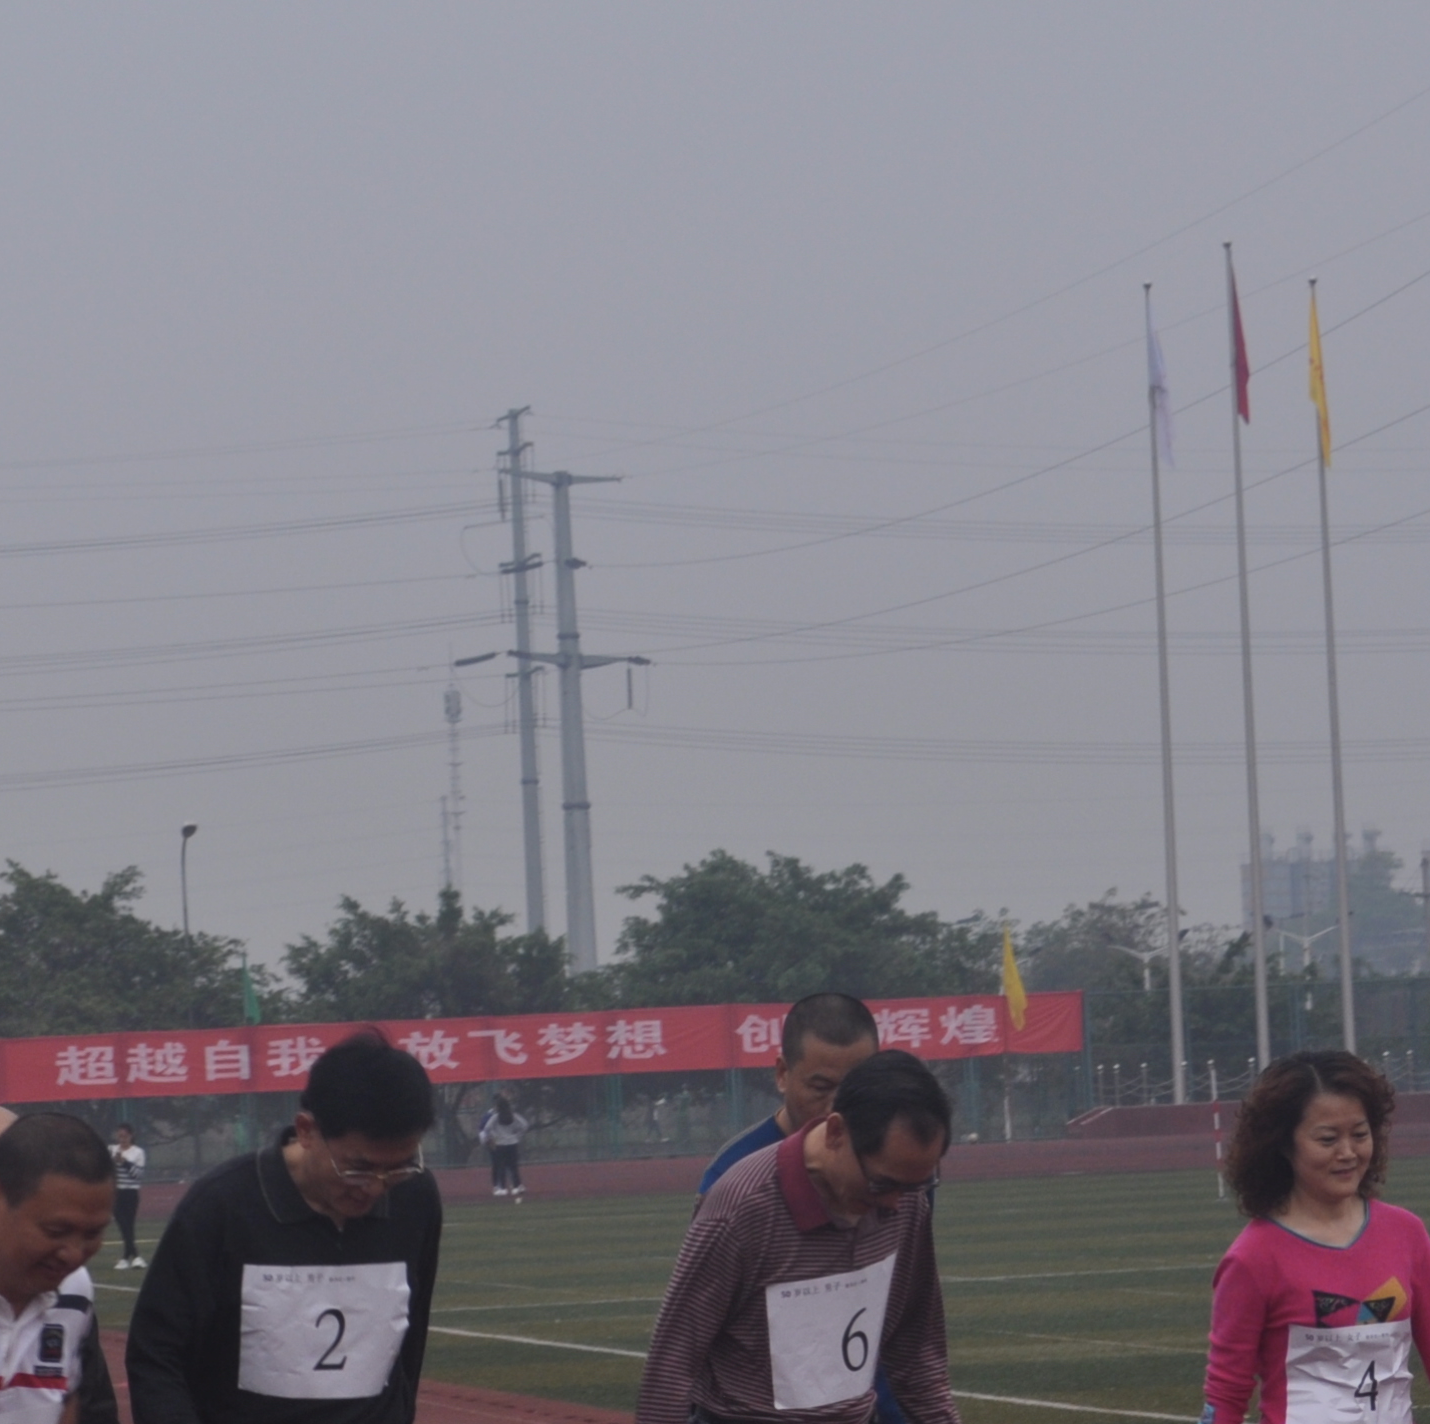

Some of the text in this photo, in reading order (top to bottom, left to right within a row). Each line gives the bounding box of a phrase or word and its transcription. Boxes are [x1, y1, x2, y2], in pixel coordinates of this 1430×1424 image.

[55, 1036, 326, 1086] 超越自我
[398, 1020, 667, 1070] 放飞梦想
[735, 1004, 999, 1054] 创辉煌
[313, 1308, 347, 1371] 2
[842, 1307, 869, 1372] 6
[1354, 1360, 1379, 1411] 4
